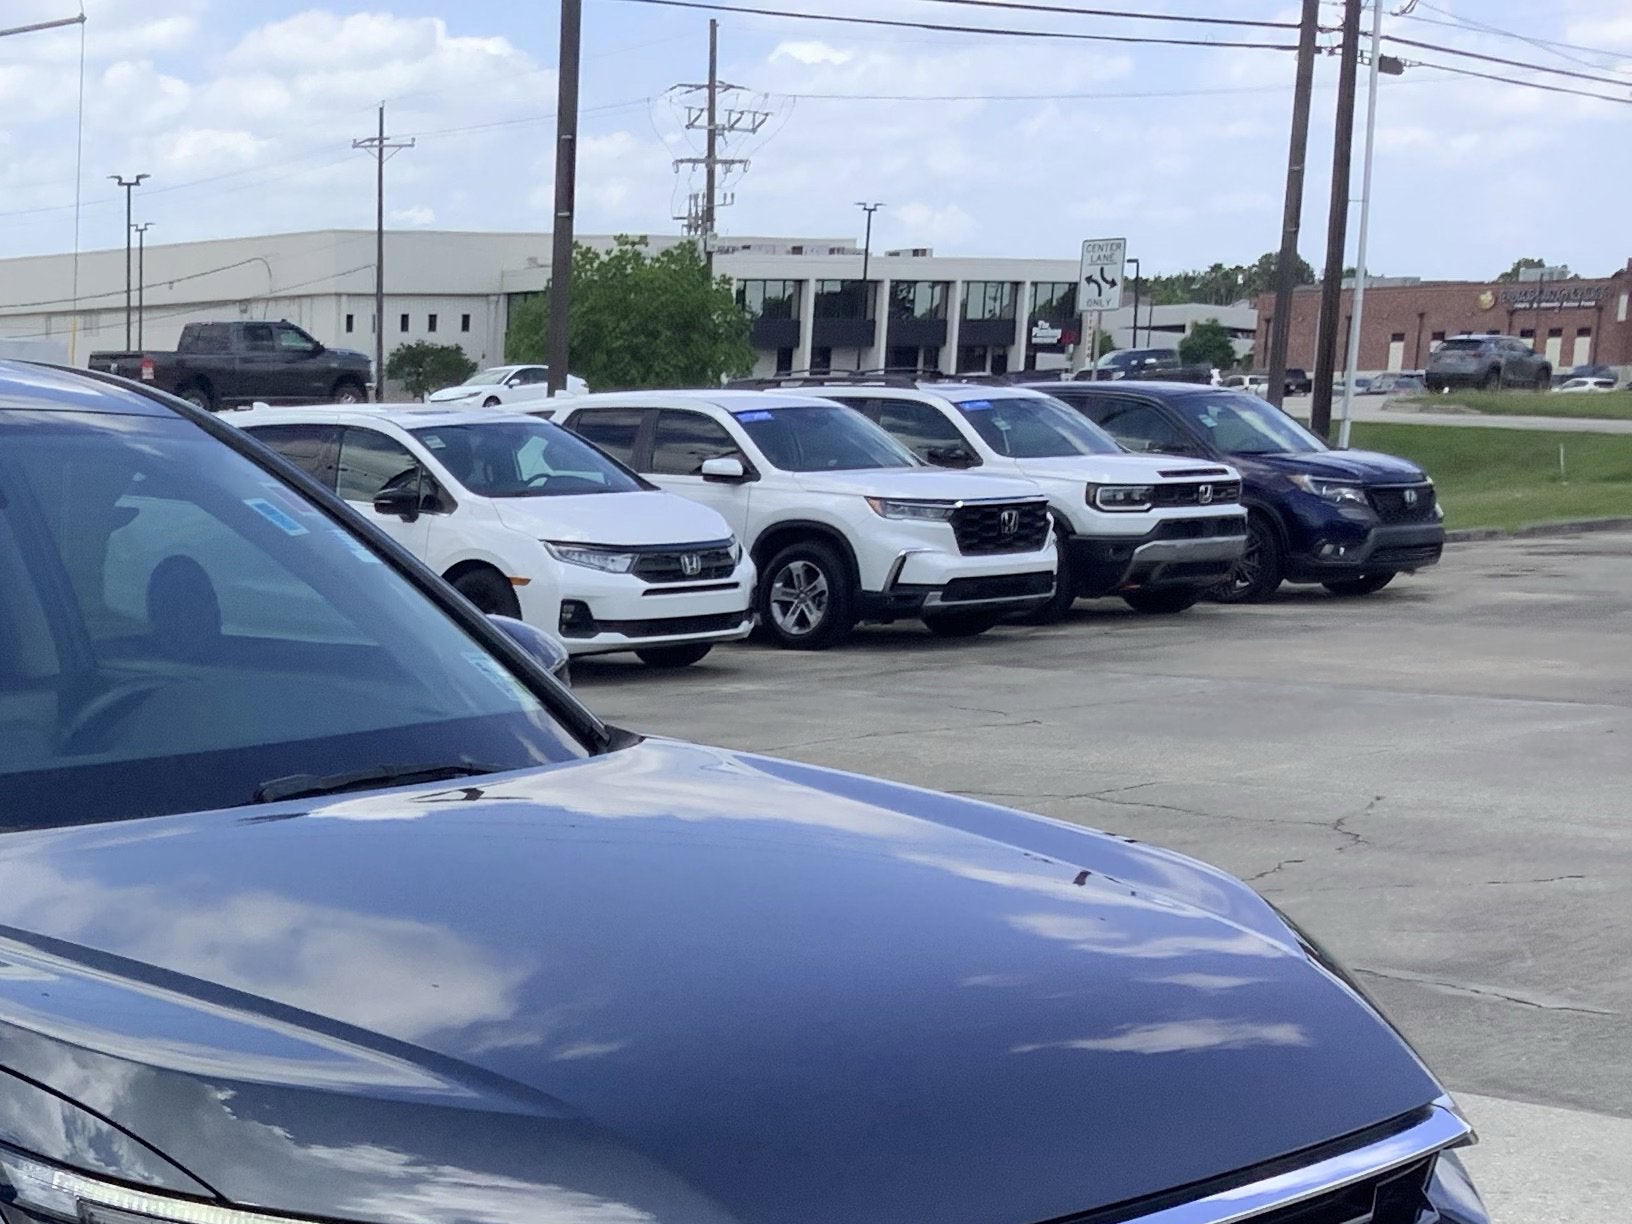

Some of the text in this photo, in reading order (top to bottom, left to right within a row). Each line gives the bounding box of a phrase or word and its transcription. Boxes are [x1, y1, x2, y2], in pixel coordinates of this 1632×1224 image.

[1086, 243, 1121, 253] CENTER
[1090, 253, 1114, 263] LANE
[1086, 298, 1111, 308] ONLY
